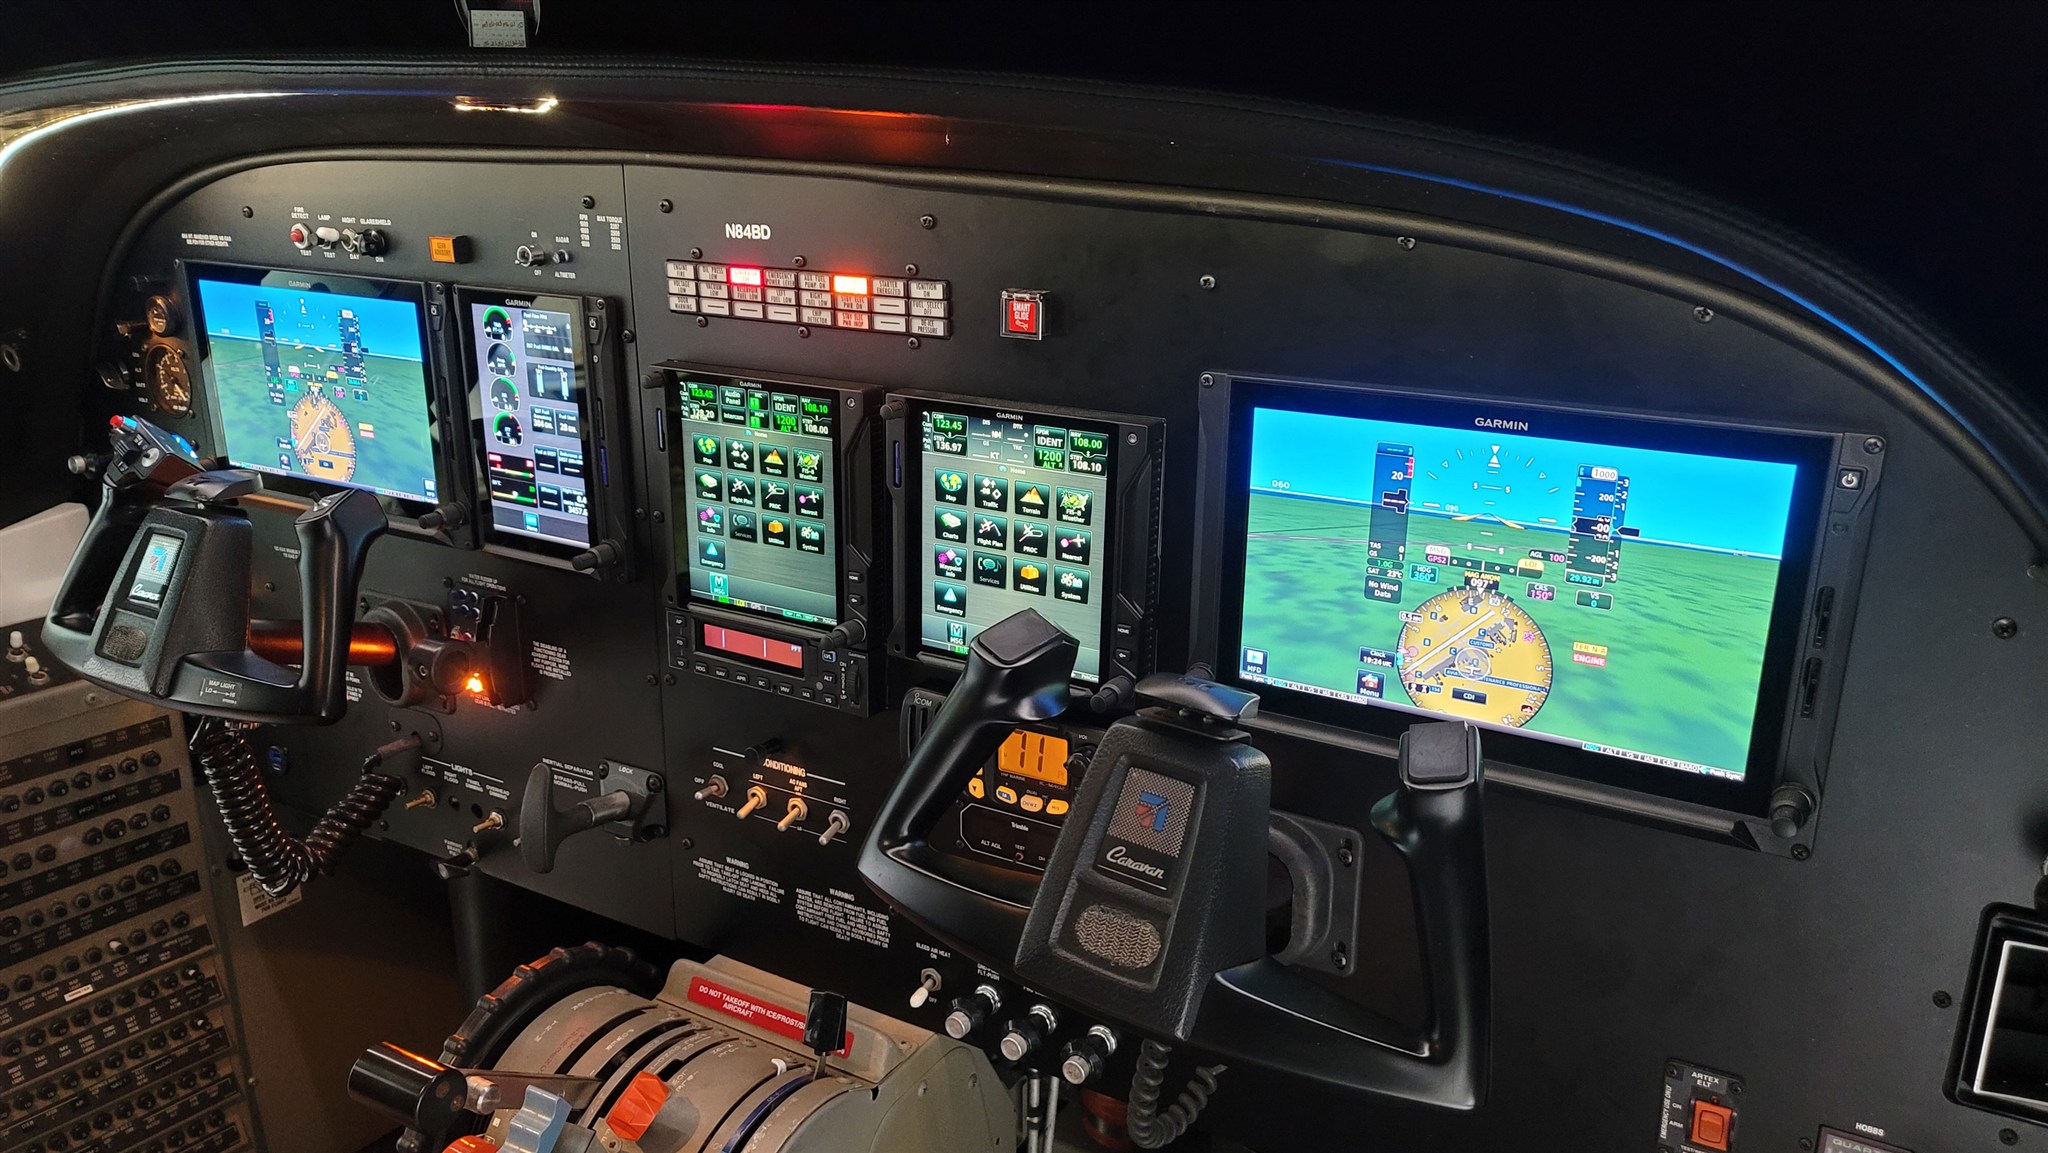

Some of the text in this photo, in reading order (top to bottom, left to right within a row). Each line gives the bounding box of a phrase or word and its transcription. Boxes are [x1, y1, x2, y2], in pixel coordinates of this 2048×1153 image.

[725, 223, 771, 240] N84BD
[288, 280, 311, 289] GARMIN
[505, 299, 531, 308] GARMIN
[740, 381, 762, 389] GARMIN
[691, 388, 714, 399] 123.45
[725, 390, 741, 398] Audio
[725, 398, 741, 406] Panel
[775, 402, 796, 413] IDENT
[804, 402, 828, 414] 108.10
[724, 412, 745, 421] Intercom
[776, 415, 796, 425] 1200
[996, 412, 1024, 421] GARMIN
[804, 423, 829, 435] 108.00
[936, 418, 963, 431] 123.45
[1474, 417, 1529, 431] GARMIN
[935, 440, 963, 453] 136.97
[1037, 435, 1063, 448] IDENT
[1073, 437, 1103, 450] 108.00
[990, 451, 1000, 460] KT
[1038, 450, 1062, 462] 1200
[1042, 461, 1056, 469] ALT
[1072, 459, 1102, 472] 108.10
[1010, 467, 1026, 476] Home
[1391, 471, 1404, 481] 20
[1594, 469, 1616, 480] 1000
[799, 473, 818, 481] Weather
[1271, 479, 1290, 489] 060
[702, 491, 717, 500] Charts
[945, 494, 957, 503] Map
[1598, 493, 1614, 502] 200
[982, 499, 999, 508] Traffic
[801, 508, 818, 517] Nearest
[1022, 507, 1041, 516] Terrain
[1062, 514, 1086, 524] Weather
[734, 531, 752, 539] Services
[942, 531, 959, 540] Charts
[768, 537, 785, 545] Utilities
[977, 537, 1004, 548] Flight Plan
[1369, 541, 1381, 549] TAS
[802, 543, 819, 552] System
[1023, 545, 1038, 554] PROC
[1062, 552, 1083, 562] Nearest
[1369, 549, 1378, 557] GS
[1529, 550, 1565, 562] AGL 100
[701, 559, 724, 568] Emergency
[1377, 560, 1394, 568] 1.0G
[1427, 554, 1446, 564] GPS2
[939, 563, 962, 573] Waypoint
[1367, 567, 1380, 575] SAT
[1417, 565, 1431, 573] HDG
[945, 570, 956, 578] Info
[1464, 570, 1479, 579] MAG
[1569, 574, 1591, 584] 29.92
[979, 576, 1000, 585] Services
[1020, 583, 1040, 593] Utilities
[1368, 580, 1398, 592] No Wind
[1061, 591, 1082, 601] System
[1374, 589, 1391, 598] Data
[937, 605, 964, 616] Emergency
[950, 637, 964, 645] MSG
[1370, 650, 1386, 658] Clock
[1574, 653, 1605, 665] ENGINE
[1363, 656, 1382, 666] 19:24
[1247, 665, 1262, 673] MFD
[220, 682, 236, 690] LIGHT
[1360, 687, 1379, 698] Menu
[1463, 692, 1475, 700] CDI
[451, 763, 473, 776] LIGHTS
[564, 763, 594, 776] SEPARATOR
[618, 766, 634, 774] LOCK
[763, 758, 806, 777] ONDITIONING
[694, 776, 705, 785] OFF
[752, 773, 763, 781] LEFT
[553, 780, 588, 793] NORMAL-PUSH
[833, 796, 847, 805] RIGHT
[705, 801, 735, 814] VENTILATE
[1011, 821, 1029, 832] Trimble
[981, 839, 1002, 850] ALT AGL
[726, 856, 750, 869] WARNING
[1106, 846, 1164, 879] Caravan
[829, 888, 855, 901] WARNING
[916, 942, 930, 952] BLEED
[939, 950, 951, 958] HEAT
[977, 969, 1000, 981] FLT-PUSH
[699, 985, 709, 994] DO
[708, 988, 722, 999] NOT
[722, 993, 750, 1011] TAKEOFF
[750, 1003, 766, 1014] WITH
[722, 1002, 755, 1018] AIRCRAFT
[1691, 1071, 1719, 1084] ARTEX
[1696, 1079, 1712, 1088] ELT
[1672, 1102, 1682, 1110] ON
[1668, 1120, 1683, 1128] ARM
[1855, 1122, 1884, 1136] HOBBS
